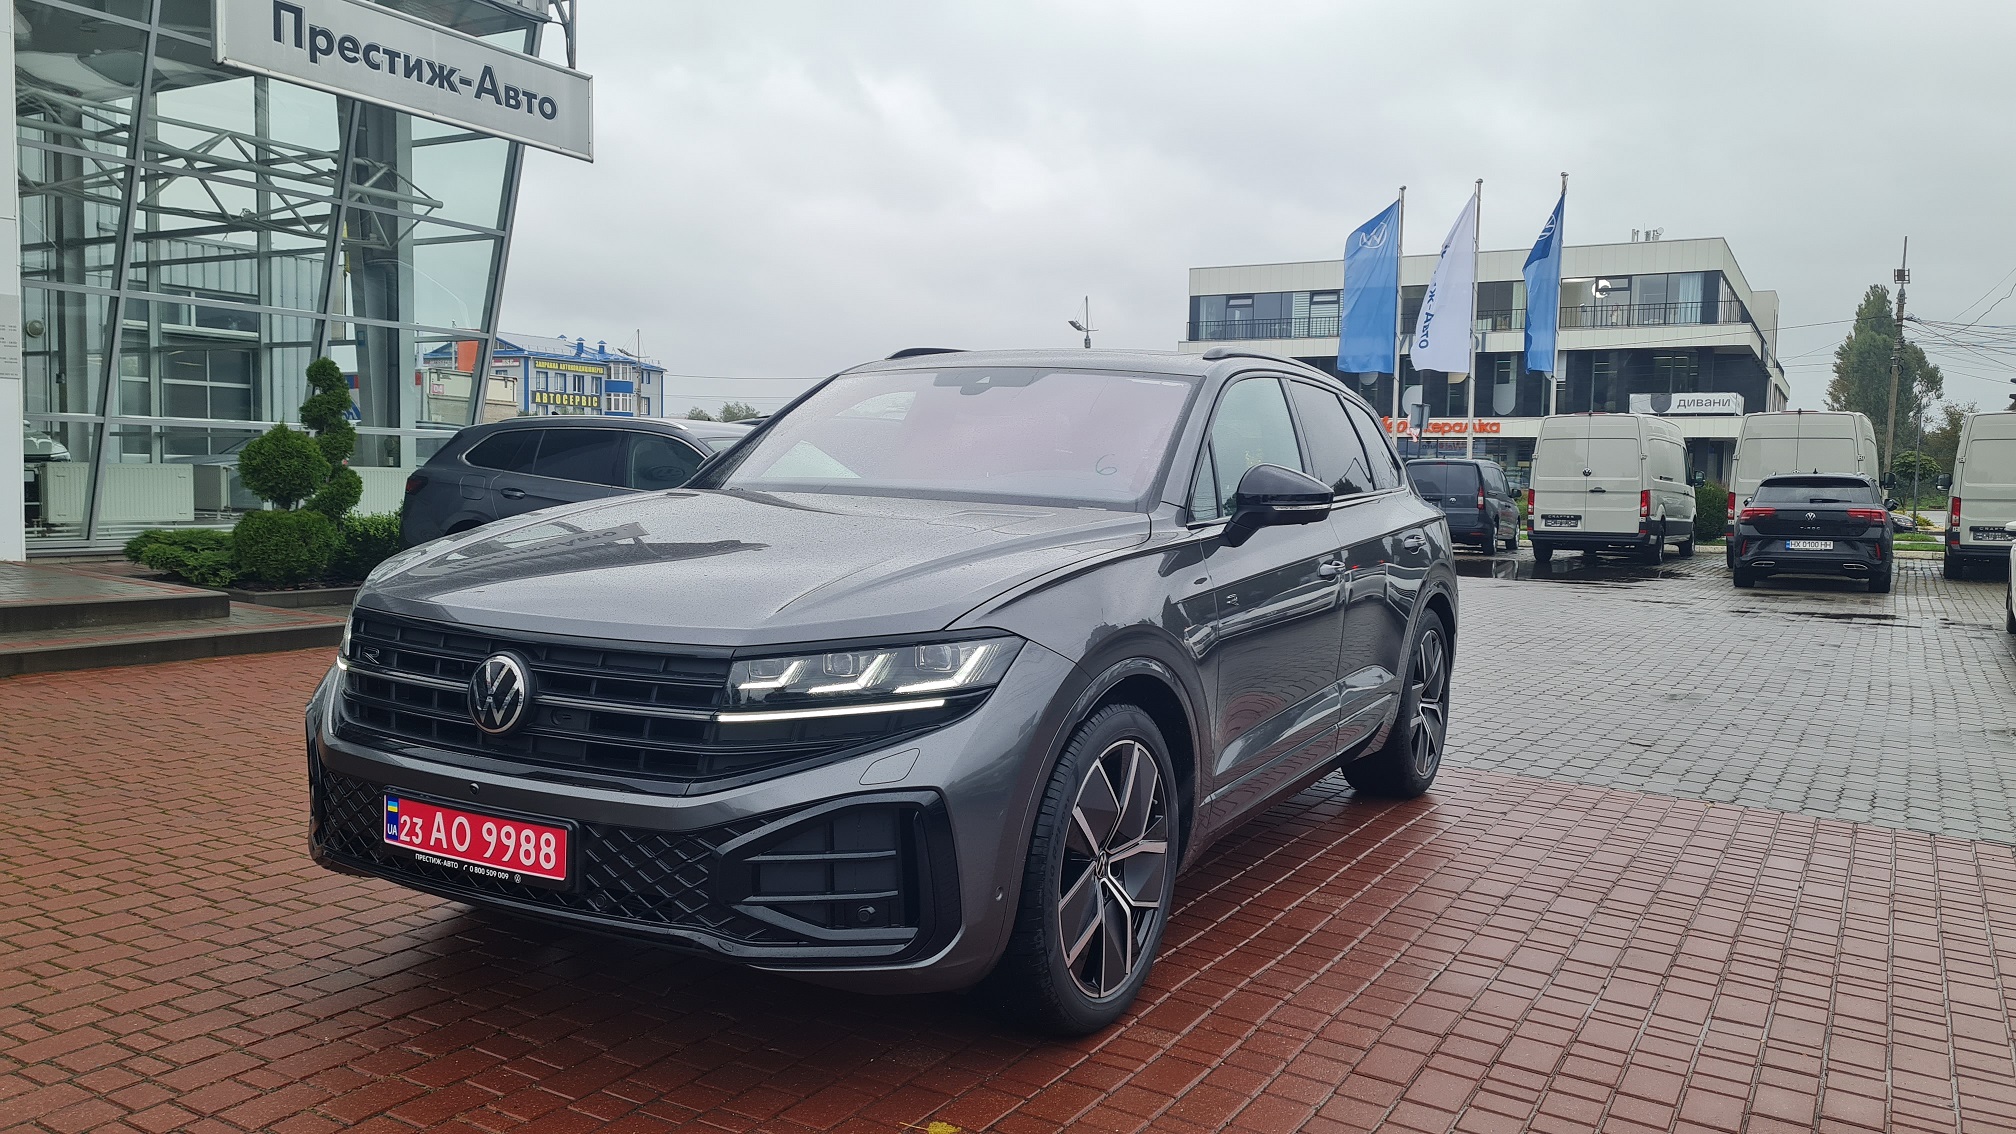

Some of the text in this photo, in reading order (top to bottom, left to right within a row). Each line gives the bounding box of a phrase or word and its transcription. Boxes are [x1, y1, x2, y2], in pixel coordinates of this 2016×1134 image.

[272, 0, 558, 121] Престиж-Авто
[535, 391, 598, 407] АВТОСЕРВІС
[1676, 398, 1731, 410] дивани
[387, 823, 398, 837] UA
[400, 811, 557, 870] 23 AO 9988
[415, 853, 509, 880] ПРЕСТИЖ-АВТО 0 800 509 009
